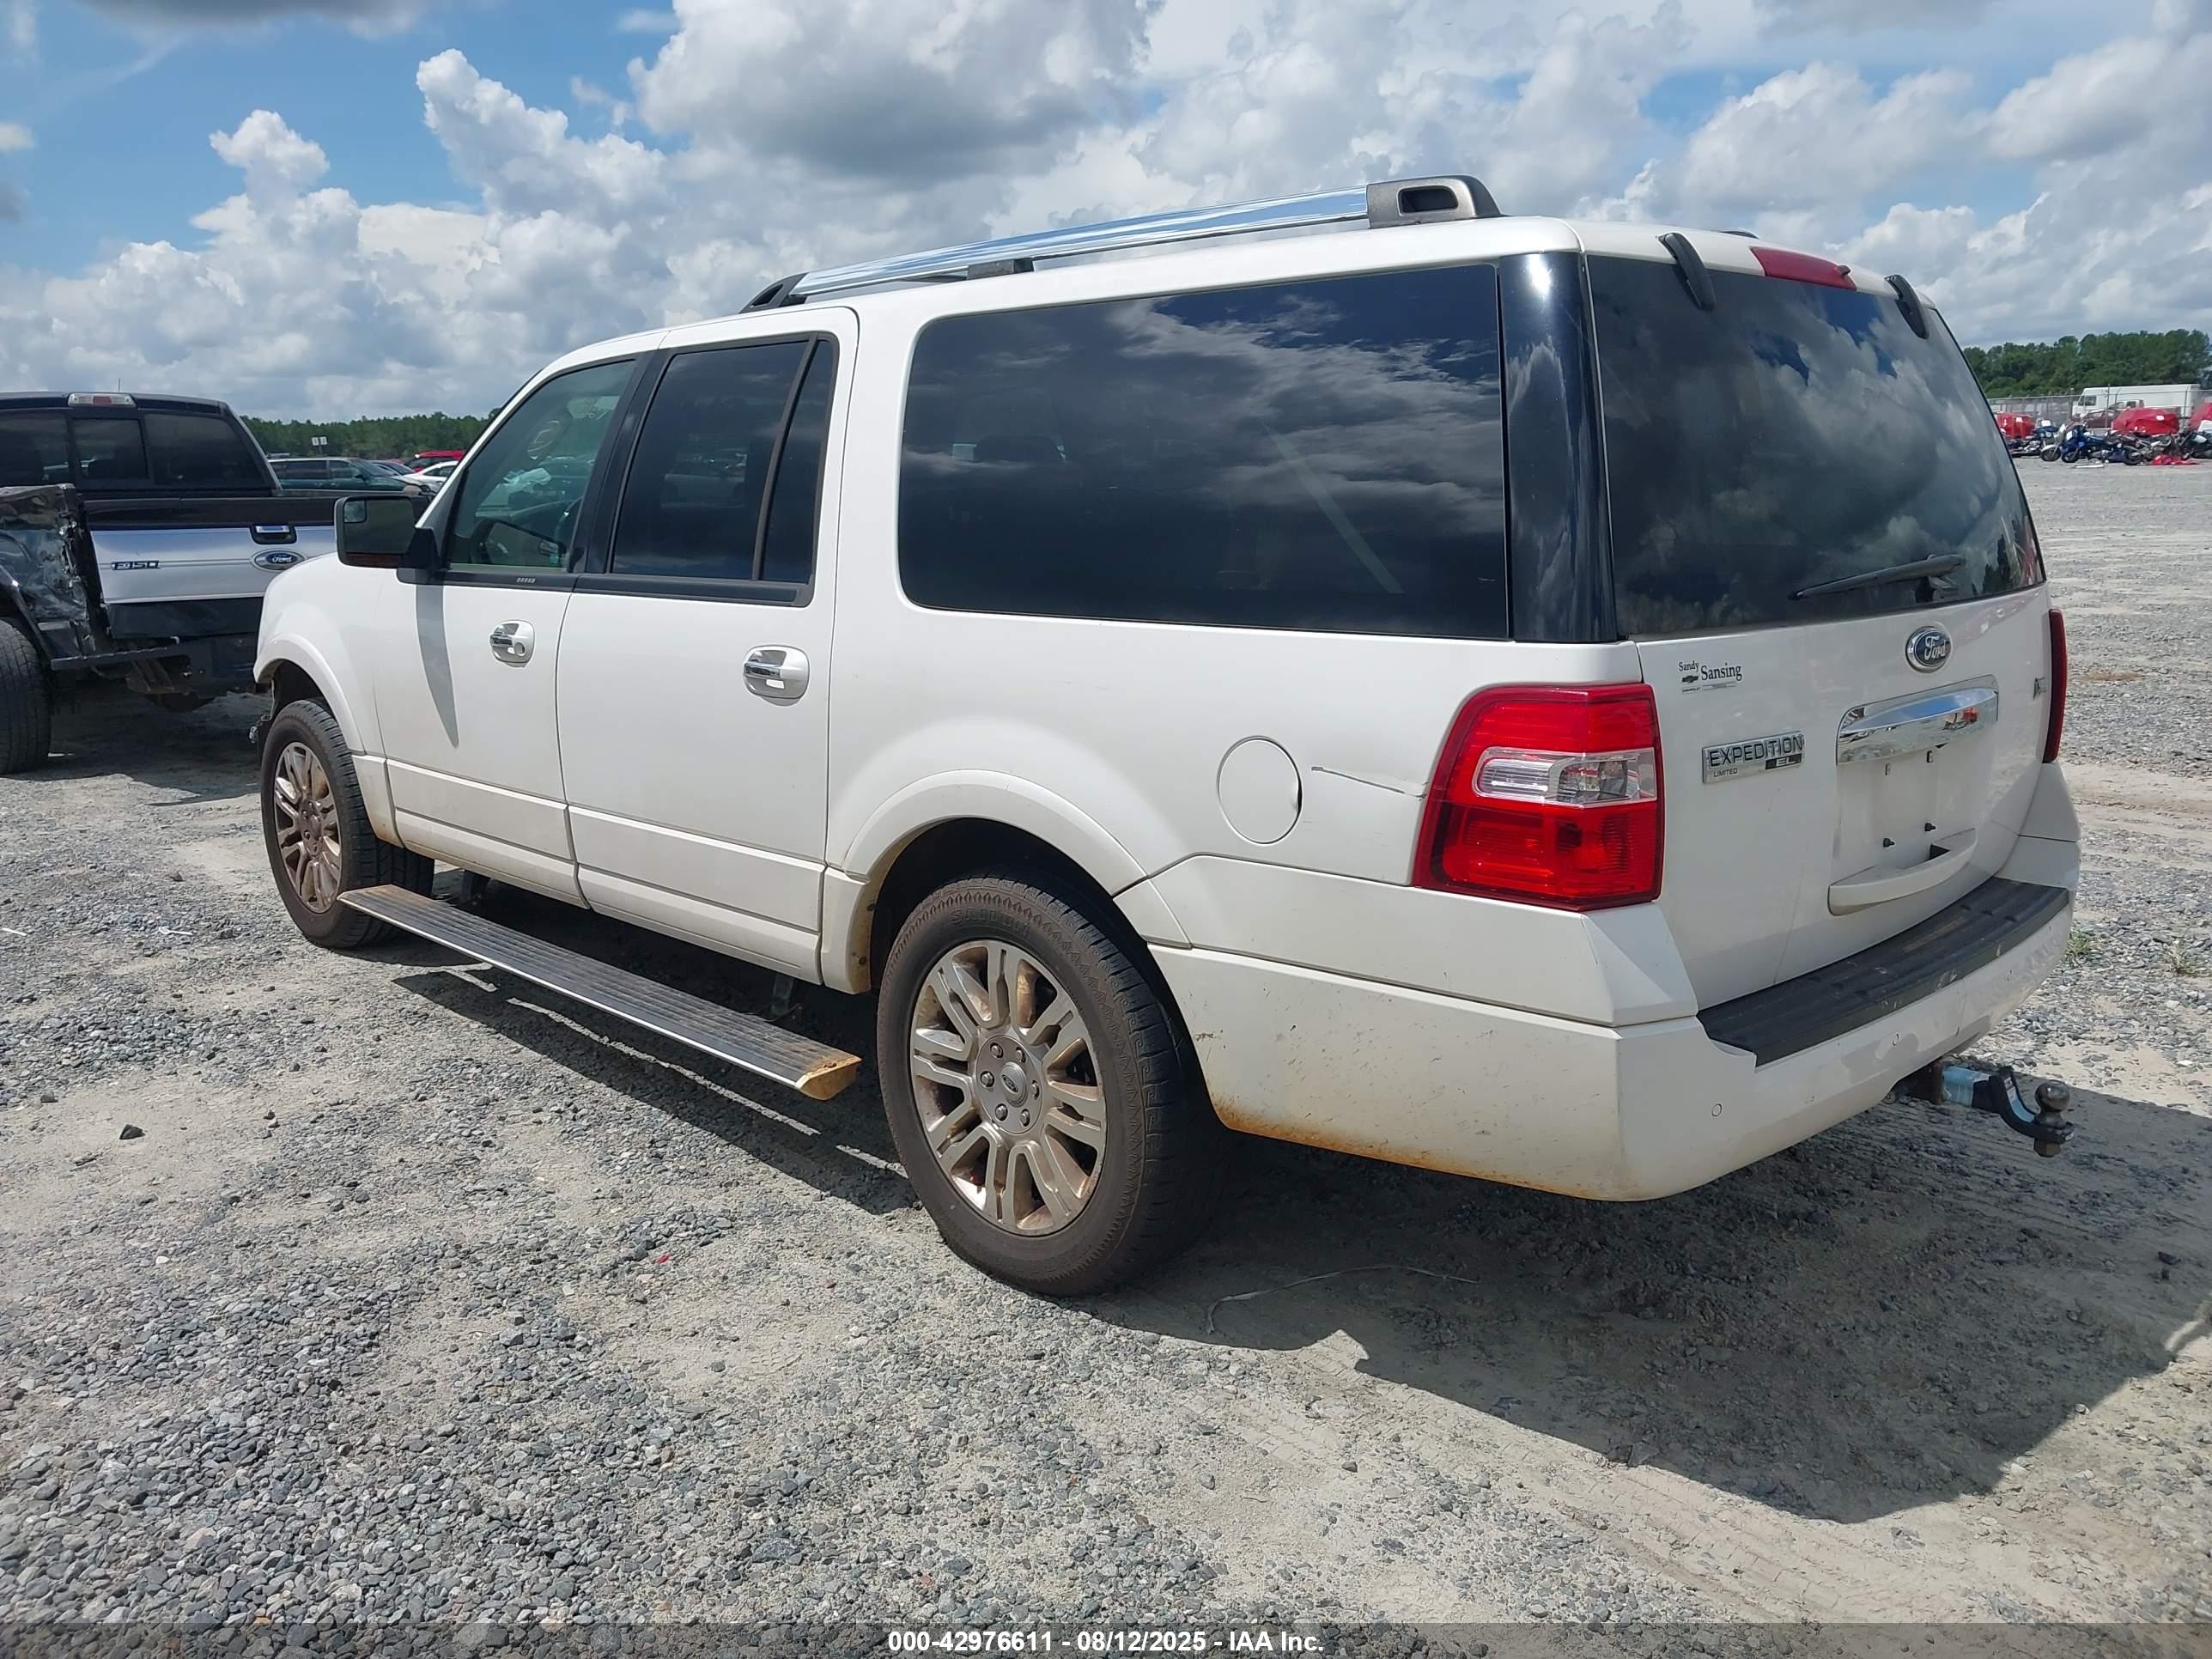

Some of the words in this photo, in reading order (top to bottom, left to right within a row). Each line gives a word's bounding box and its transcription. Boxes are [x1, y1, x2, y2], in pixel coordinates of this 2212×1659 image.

[1923, 635, 1947, 660] Ford
[1678, 659, 1699, 672] Sandy
[1700, 662, 1742, 681] Sansing
[1709, 733, 1804, 767] EXPEDITION
[1713, 768, 1738, 777] LIMITED
[1775, 757, 1796, 767] EL
